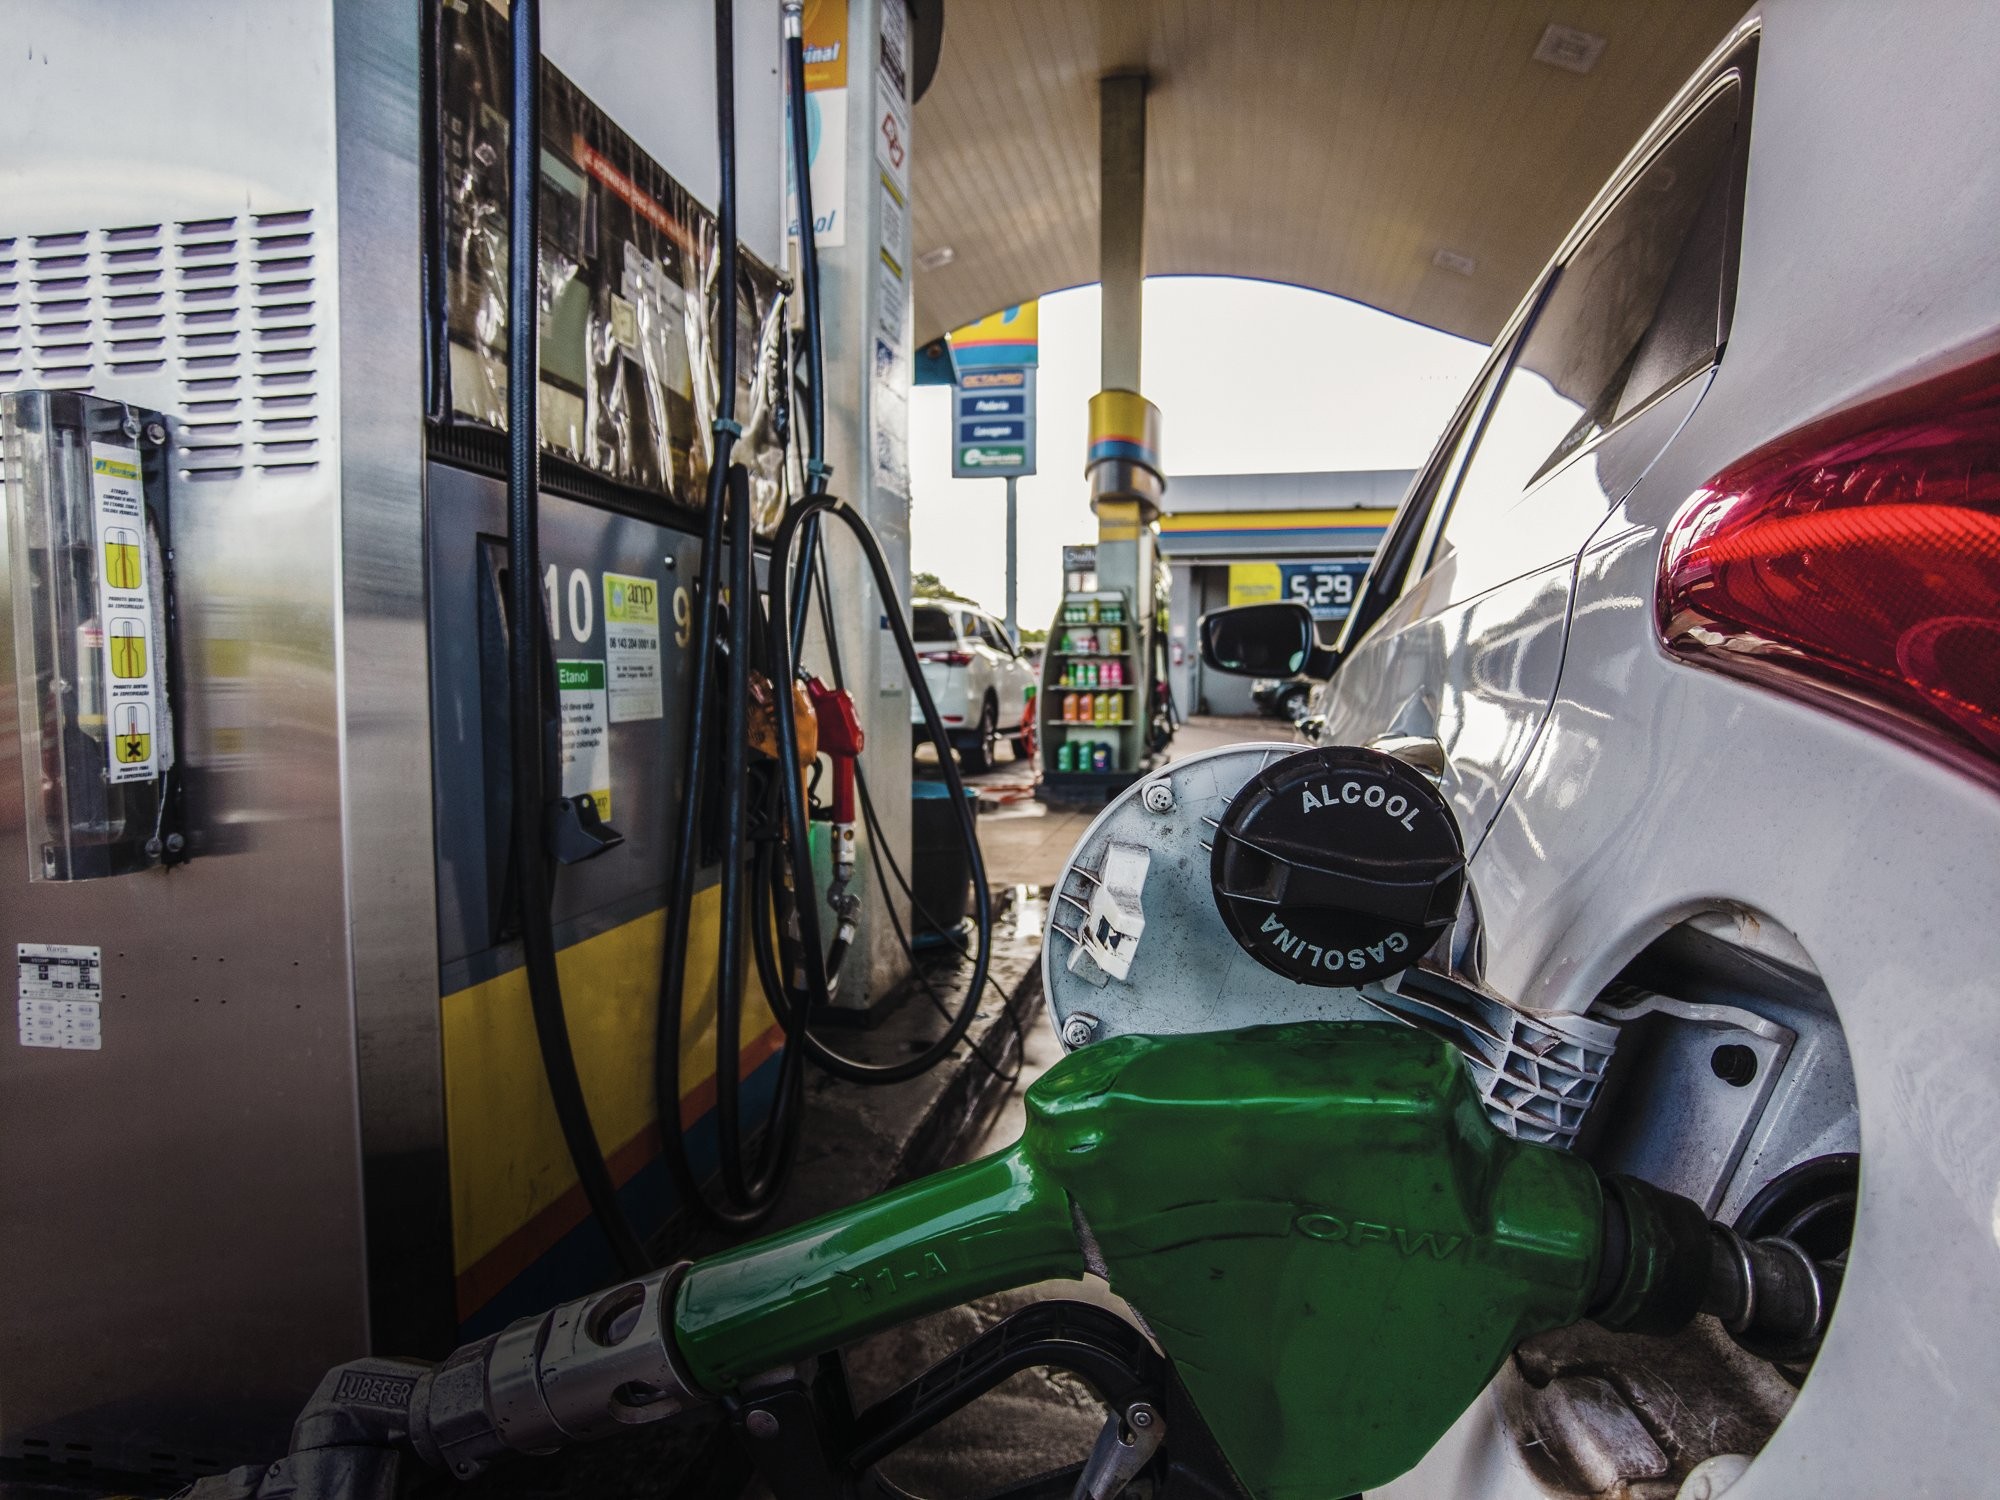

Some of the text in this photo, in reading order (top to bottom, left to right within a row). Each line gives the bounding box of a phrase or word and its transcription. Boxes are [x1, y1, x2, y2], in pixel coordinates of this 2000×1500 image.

[544, 563, 593, 643] 10
[628, 583, 653, 612] anp
[1291, 575, 1353, 607] 5,29
[673, 586, 692, 648] 9
[559, 669, 588, 684] Etanol
[1302, 782, 1420, 833] ÁLCOOL
[1260, 912, 1409, 971] GASOLINA
[1296, 1213, 1463, 1260] OPW
[338, 1376, 411, 1406] LUBEFER
